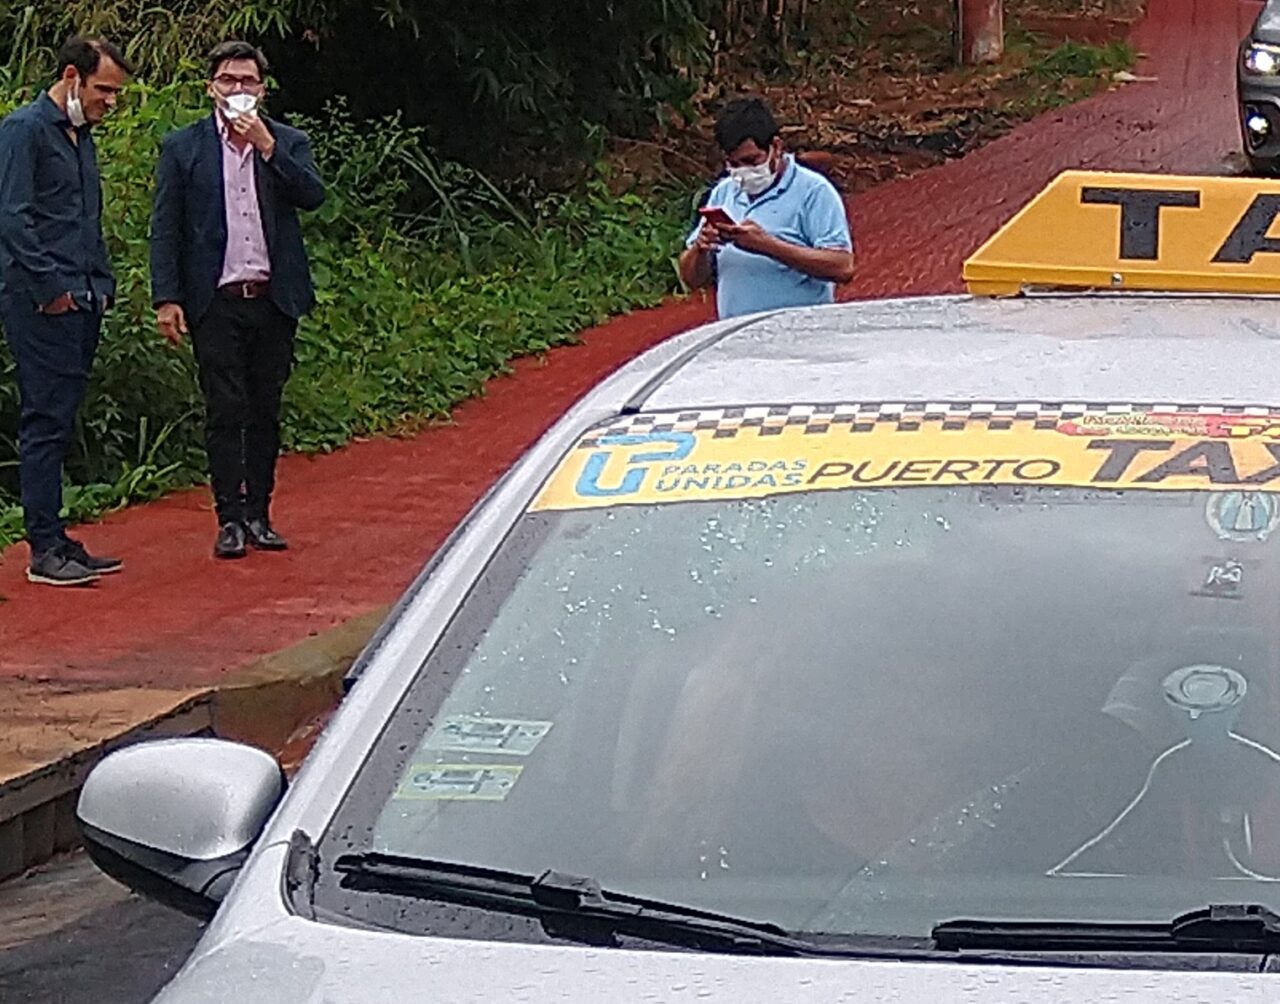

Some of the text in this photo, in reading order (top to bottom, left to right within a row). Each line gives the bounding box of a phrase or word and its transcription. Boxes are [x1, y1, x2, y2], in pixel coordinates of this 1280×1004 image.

[663, 459, 807, 476] PARADAS
[806, 459, 1061, 484] PUERTO
[655, 472, 802, 492] UNIDAS
